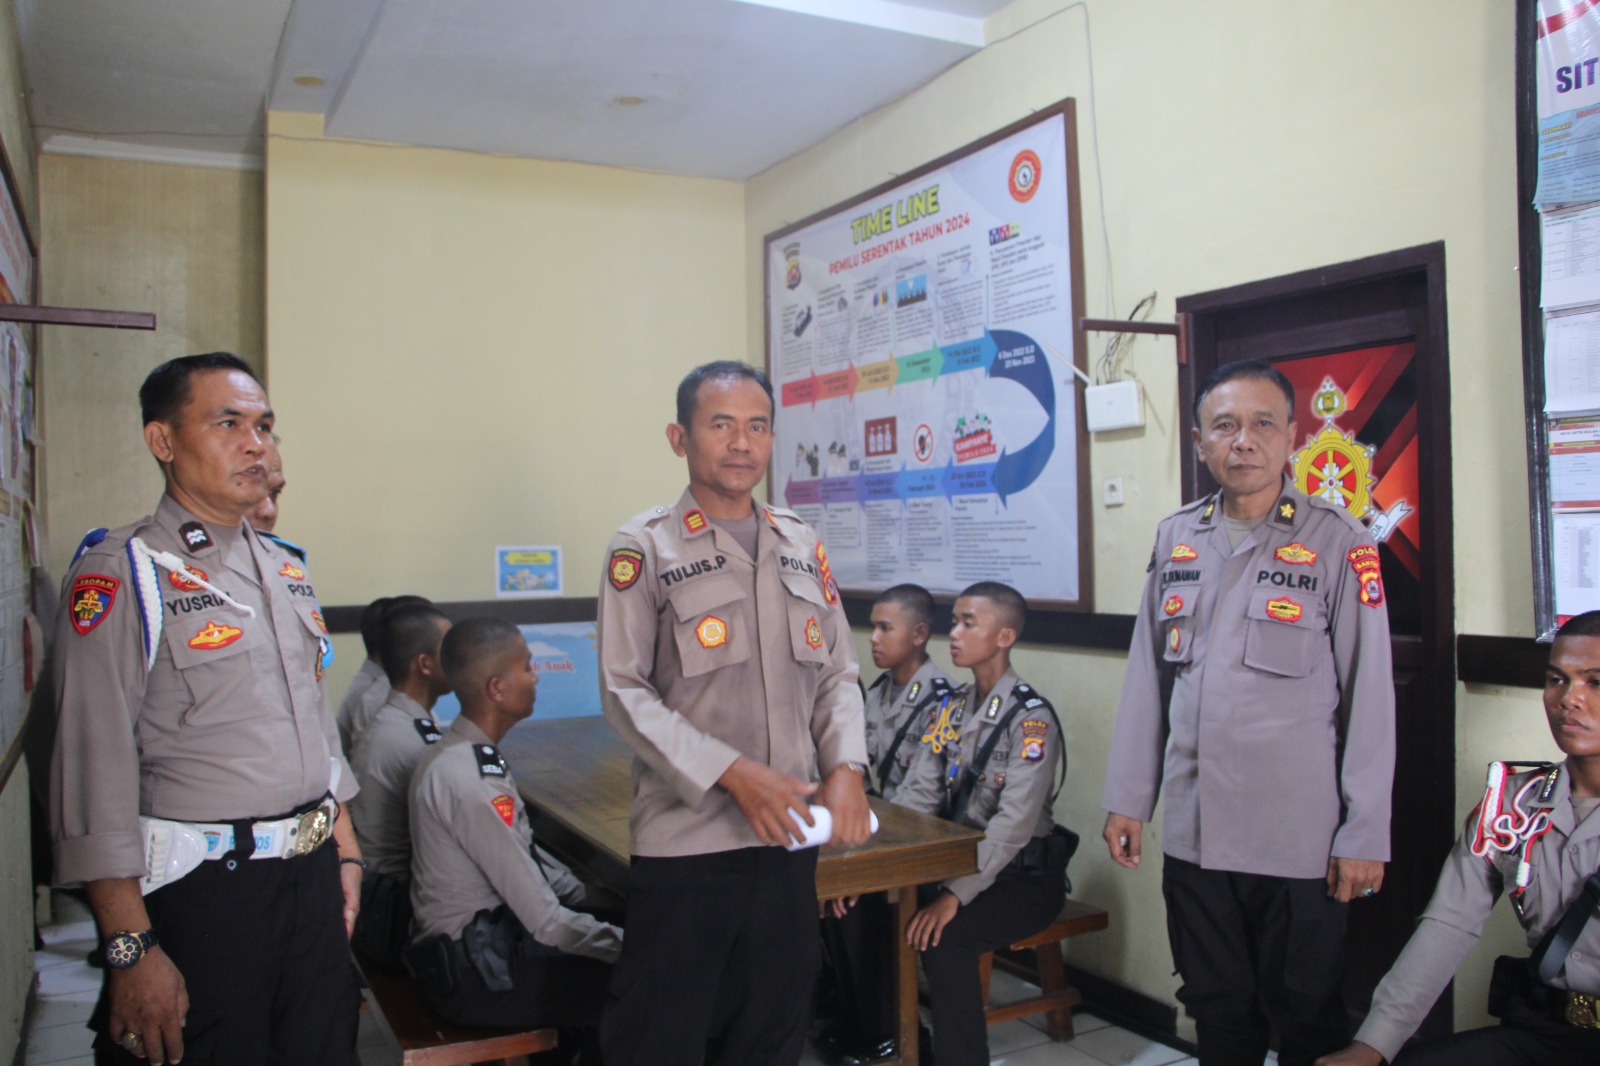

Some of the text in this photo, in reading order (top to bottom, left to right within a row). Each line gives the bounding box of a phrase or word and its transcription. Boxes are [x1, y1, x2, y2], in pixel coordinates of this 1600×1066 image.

[850, 184, 940, 245] TIME LINE
[829, 210, 971, 276] PEMILU SERENTAK TAHUN 2024
[660, 555, 726, 586] TULUS.P
[780, 555, 818, 578] POLRI
[287, 584, 316, 598] POLR
[1257, 570, 1318, 592] POLRI
